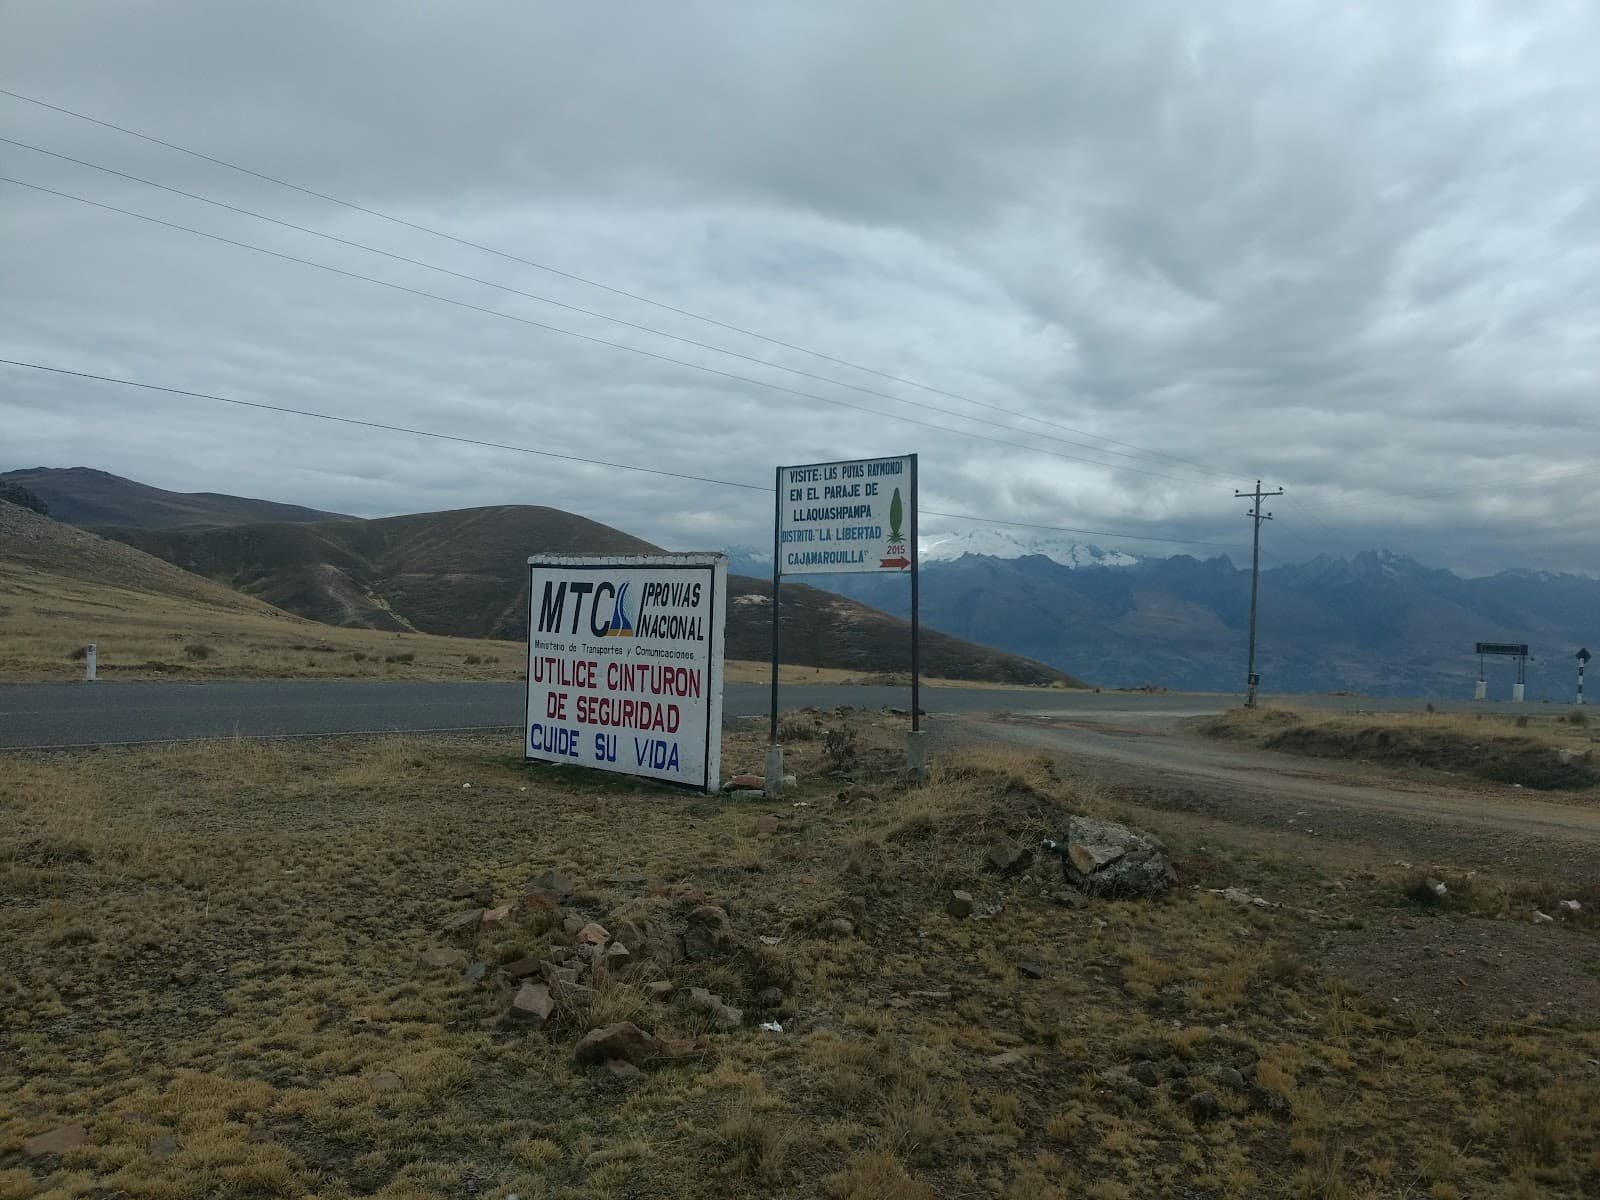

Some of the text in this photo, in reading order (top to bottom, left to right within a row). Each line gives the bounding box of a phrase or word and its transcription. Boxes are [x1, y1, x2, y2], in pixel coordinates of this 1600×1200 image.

[790, 469, 822, 483] VISITE:
[824, 466, 837, 480] LAS
[842, 464, 864, 479] PUYAS
[790, 483, 879, 501] EN EL PARAJE DE
[793, 504, 872, 521] LLAQUASHPAMPA
[836, 526, 881, 541] LIBERTAD
[887, 545, 905, 555] 2015
[645, 582, 701, 608] PROVIAS
[538, 581, 616, 638] MTC
[638, 615, 703, 641] NACIONAL
[534, 639, 694, 660] Ministerio de Transportes y Comunicaciones
[534, 656, 701, 699] UTILICE CINTURON
[546, 692, 680, 734] DE SEGURIDAD
[531, 723, 680, 772] CUIDE SU VIDA
